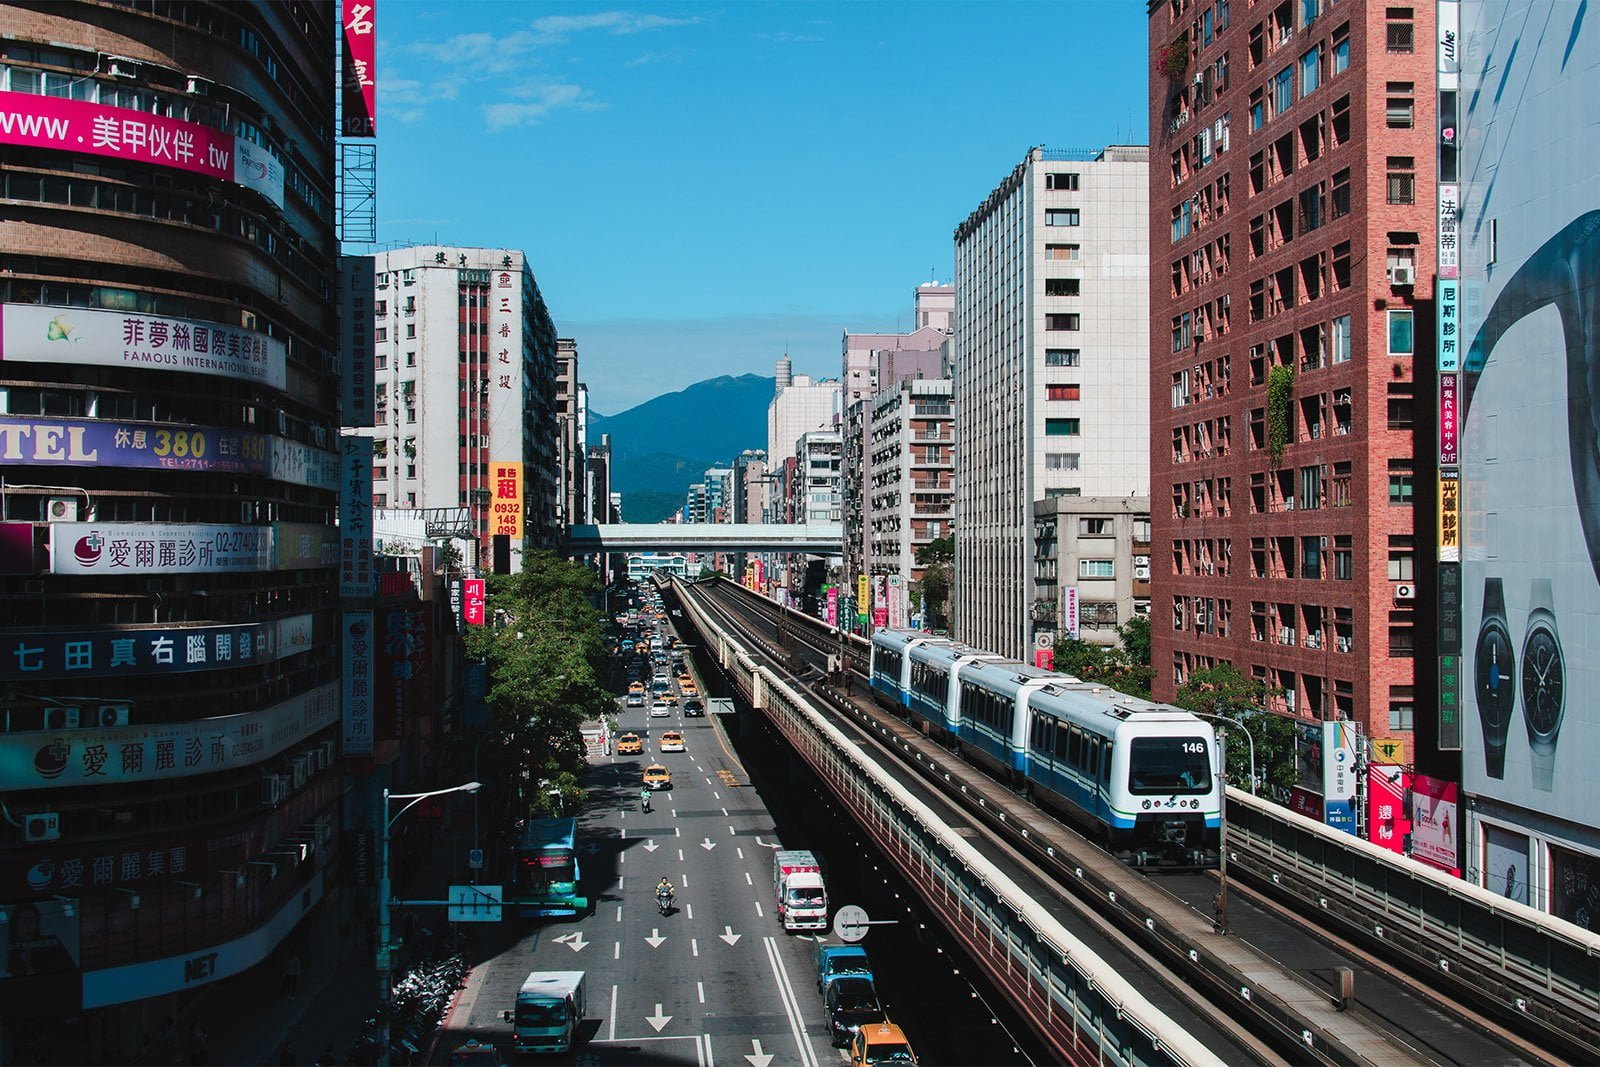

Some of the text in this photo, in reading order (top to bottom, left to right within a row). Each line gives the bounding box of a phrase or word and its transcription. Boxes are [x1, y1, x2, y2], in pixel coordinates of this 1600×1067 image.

[1442, 287, 1455, 353] 尼斯診所
[498, 298, 512, 390] 三普建設
[123, 350, 178, 366] FAMOUS
[182, 356, 249, 375] INTERNATIONAL
[1443, 389, 1454, 451] 現代美容中心
[114, 427, 148, 449] 休息
[153, 429, 206, 459] 380
[1441, 453, 1457, 463] 6/F
[497, 479, 517, 499] 租
[494, 503, 520, 514] 0932
[497, 515, 517, 525] 148
[497, 526, 517, 536] 099
[109, 539, 214, 568] 愛爾麗診所
[413, 610, 427, 674] TASTY
[82, 734, 226, 778] 愛爾麗診所
[1182, 742, 1204, 754] 146
[1378, 805, 1394, 852] 遠傳
[60, 845, 187, 889] 愛爾麗集團
[184, 952, 218, 983] NET
